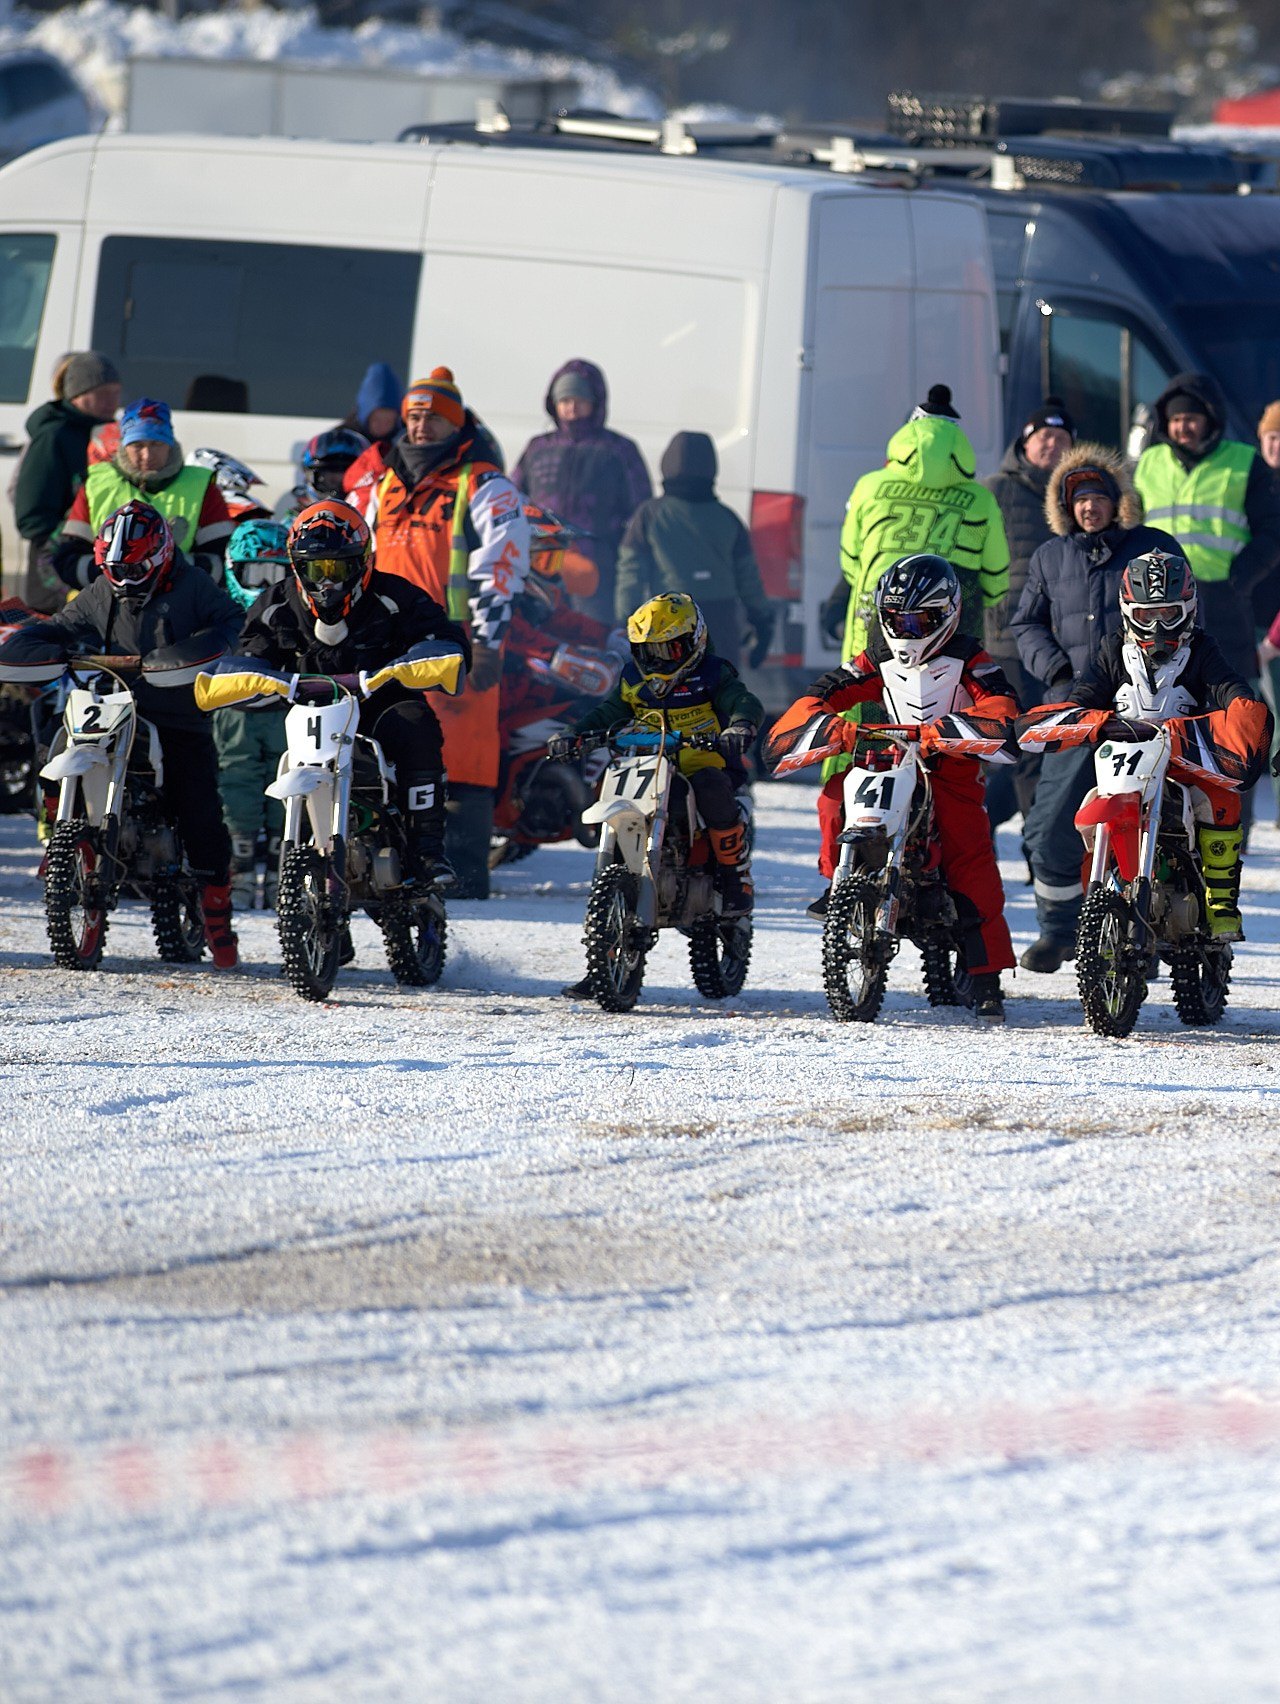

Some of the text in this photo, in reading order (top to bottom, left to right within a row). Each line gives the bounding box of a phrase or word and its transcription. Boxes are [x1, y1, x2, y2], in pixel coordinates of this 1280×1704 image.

[878, 501, 966, 558] 234
[83, 705, 101, 734] 2
[306, 715, 322, 750] 4
[1018, 723, 1096, 743] KTM
[1112, 750, 1144, 777] 71
[612, 767, 657, 801] 17
[854, 776, 896, 811] 41
